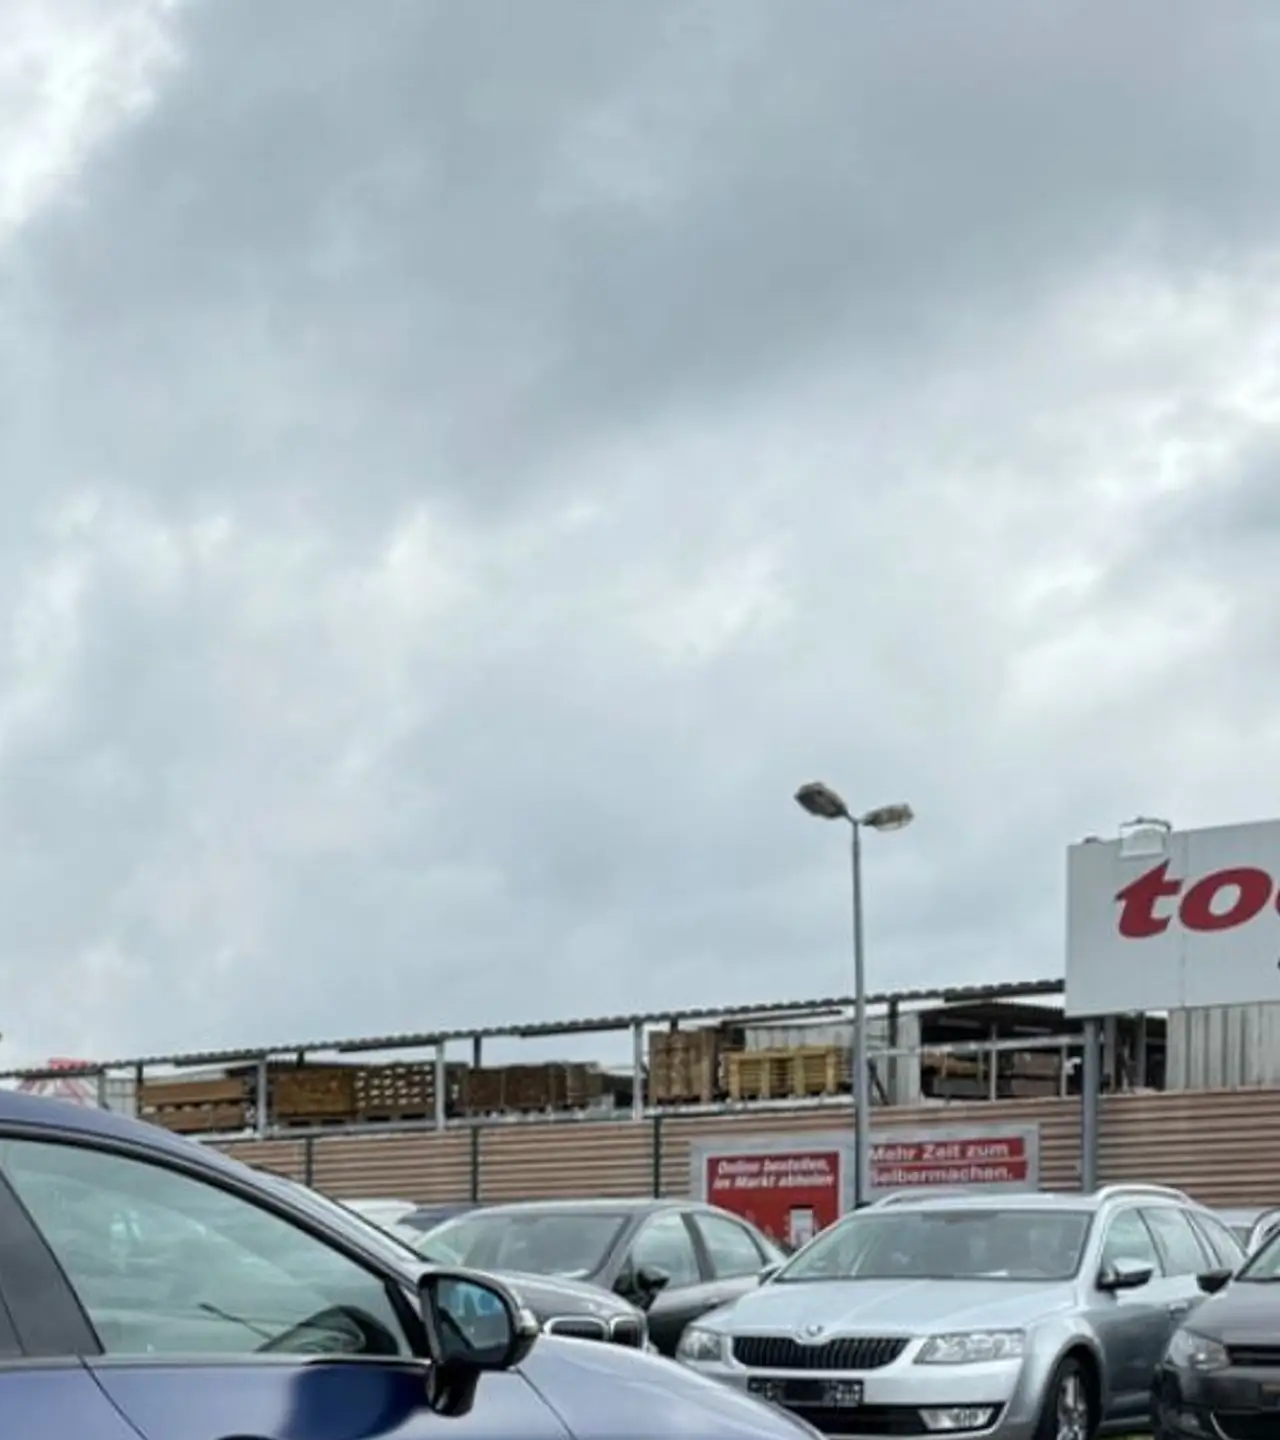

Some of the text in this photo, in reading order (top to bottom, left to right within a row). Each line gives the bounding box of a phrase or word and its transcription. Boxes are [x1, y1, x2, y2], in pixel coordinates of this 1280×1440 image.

[1114, 858, 1280, 938] to
[922, 1143, 961, 1160] Zeit
[966, 1142, 1010, 1158] zum
